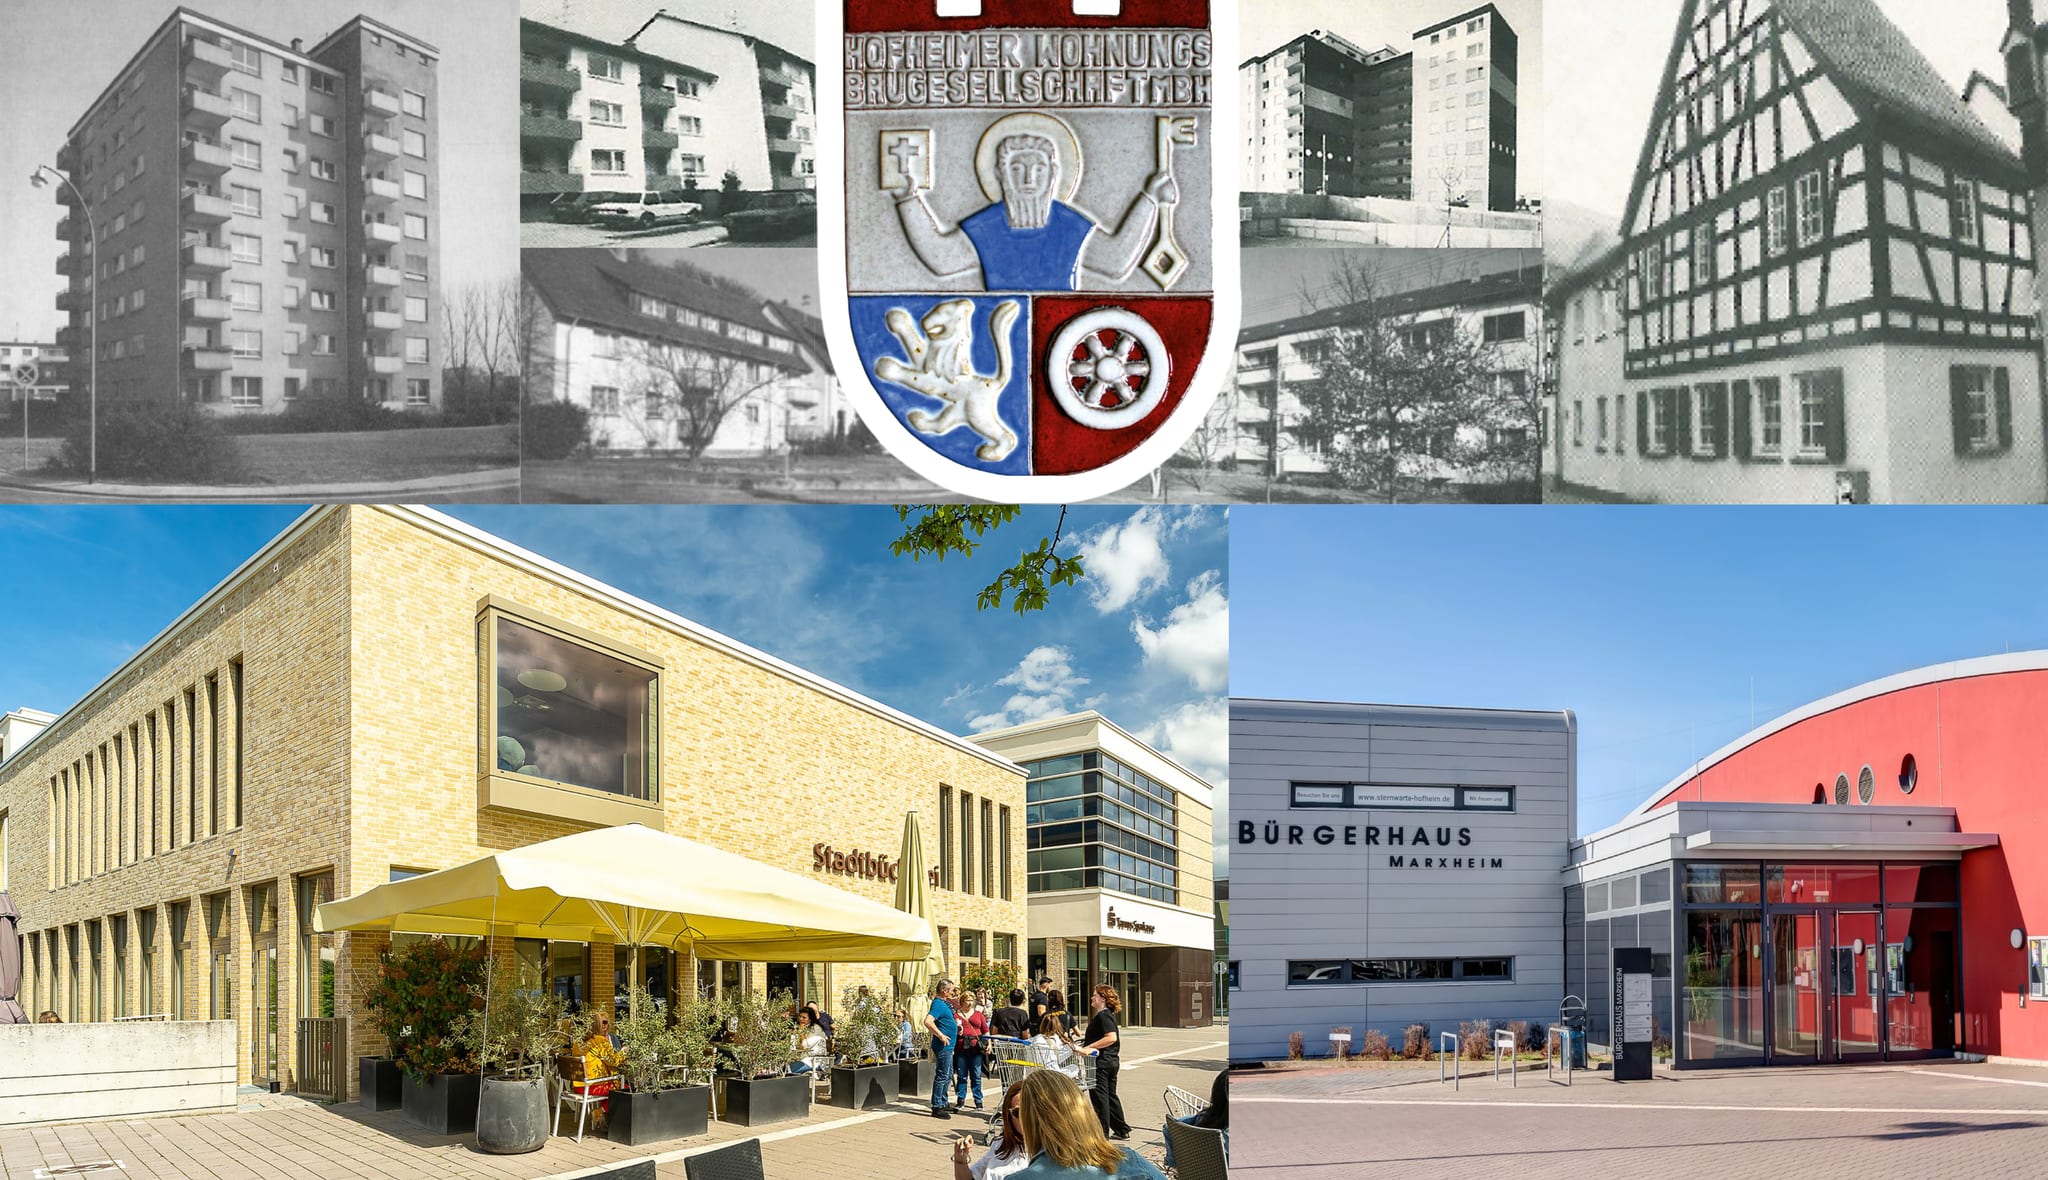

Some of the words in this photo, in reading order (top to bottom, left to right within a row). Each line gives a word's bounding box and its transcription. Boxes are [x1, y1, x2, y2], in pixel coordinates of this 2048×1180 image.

[845, 34, 1020, 69] HOFHEIMER
[1035, 34, 1211, 68] WOHNUNGS
[1358, 794, 1451, 803] www.sternwarte-hofheim.de
[1238, 820, 1472, 847] BÜRGERHAUS
[1389, 855, 1503, 869] MARXHEIM
